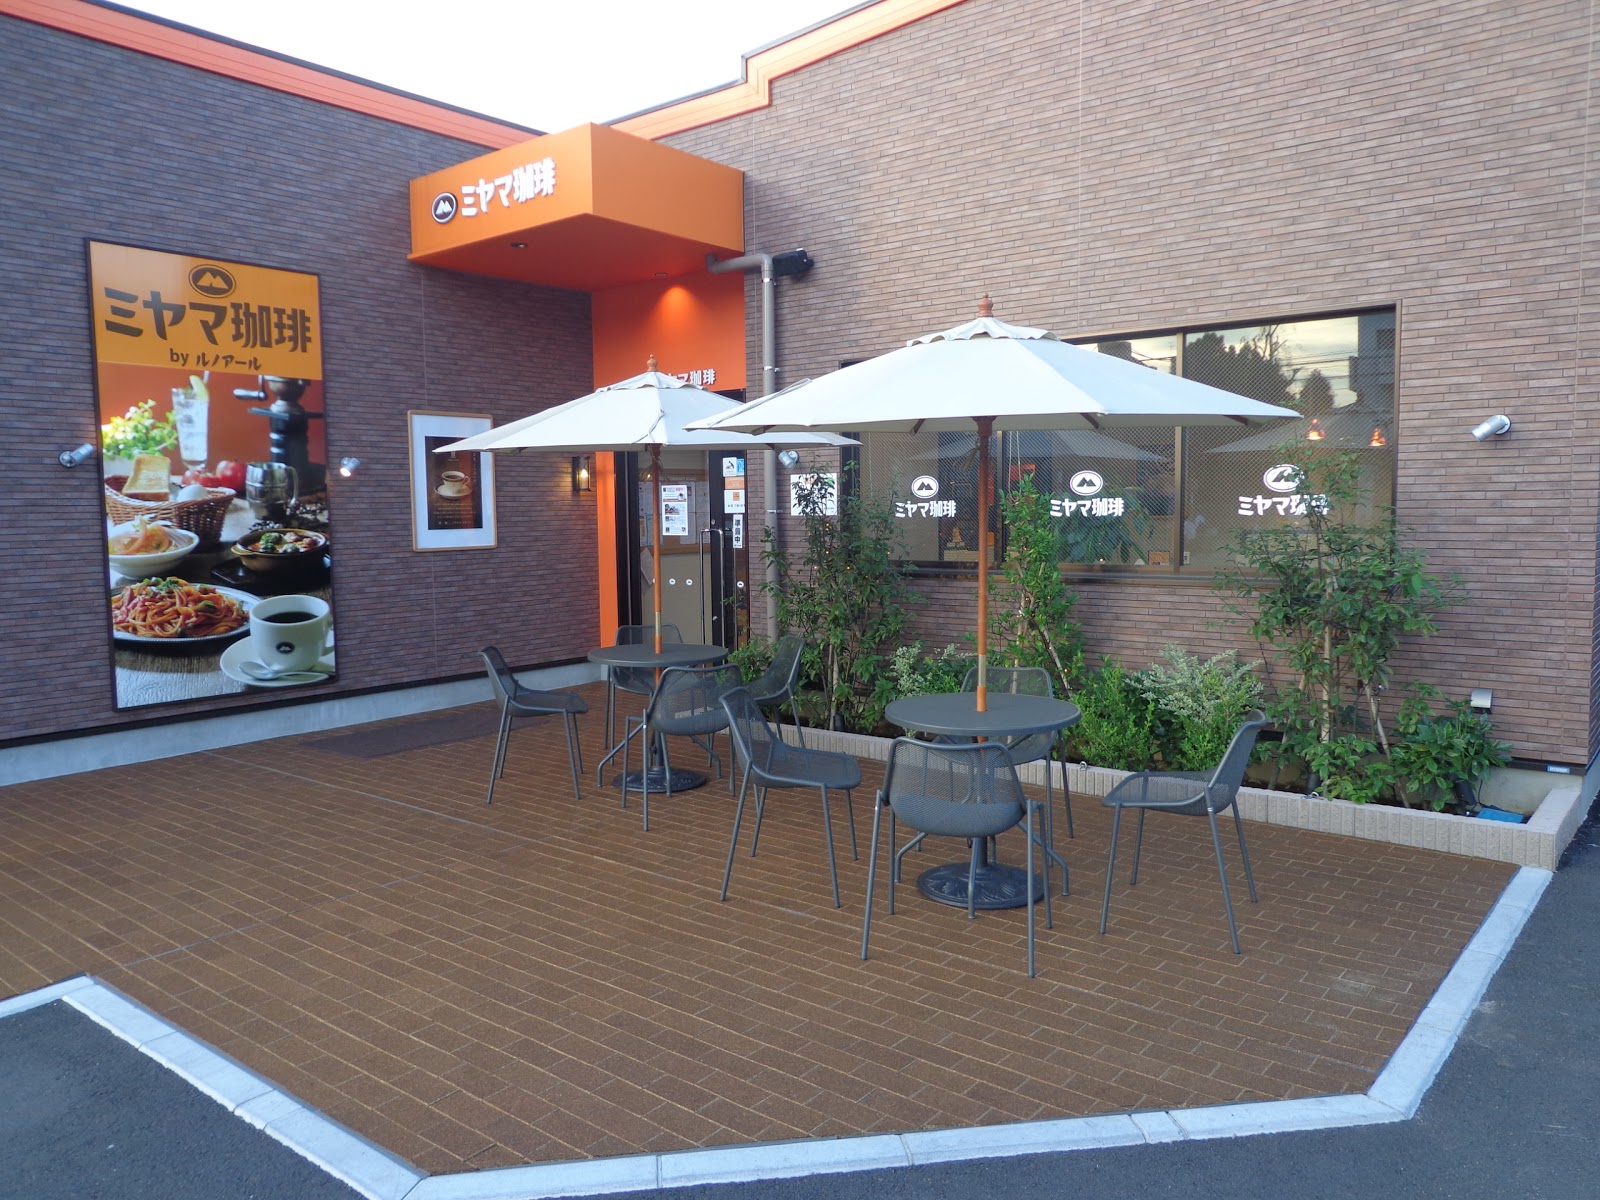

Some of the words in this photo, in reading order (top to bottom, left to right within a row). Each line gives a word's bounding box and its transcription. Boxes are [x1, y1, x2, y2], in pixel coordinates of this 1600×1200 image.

[461, 157, 556, 217] ミヤマ珈琲
[104, 287, 312, 352] ミヤマ珈琲
[169, 348, 189, 366] by
[196, 351, 262, 371] ルノアール
[667, 368, 716, 386] マ珈琲
[895, 500, 957, 518] ミヤマ珈琲
[1050, 497, 1125, 518] ミヤマ珈琲
